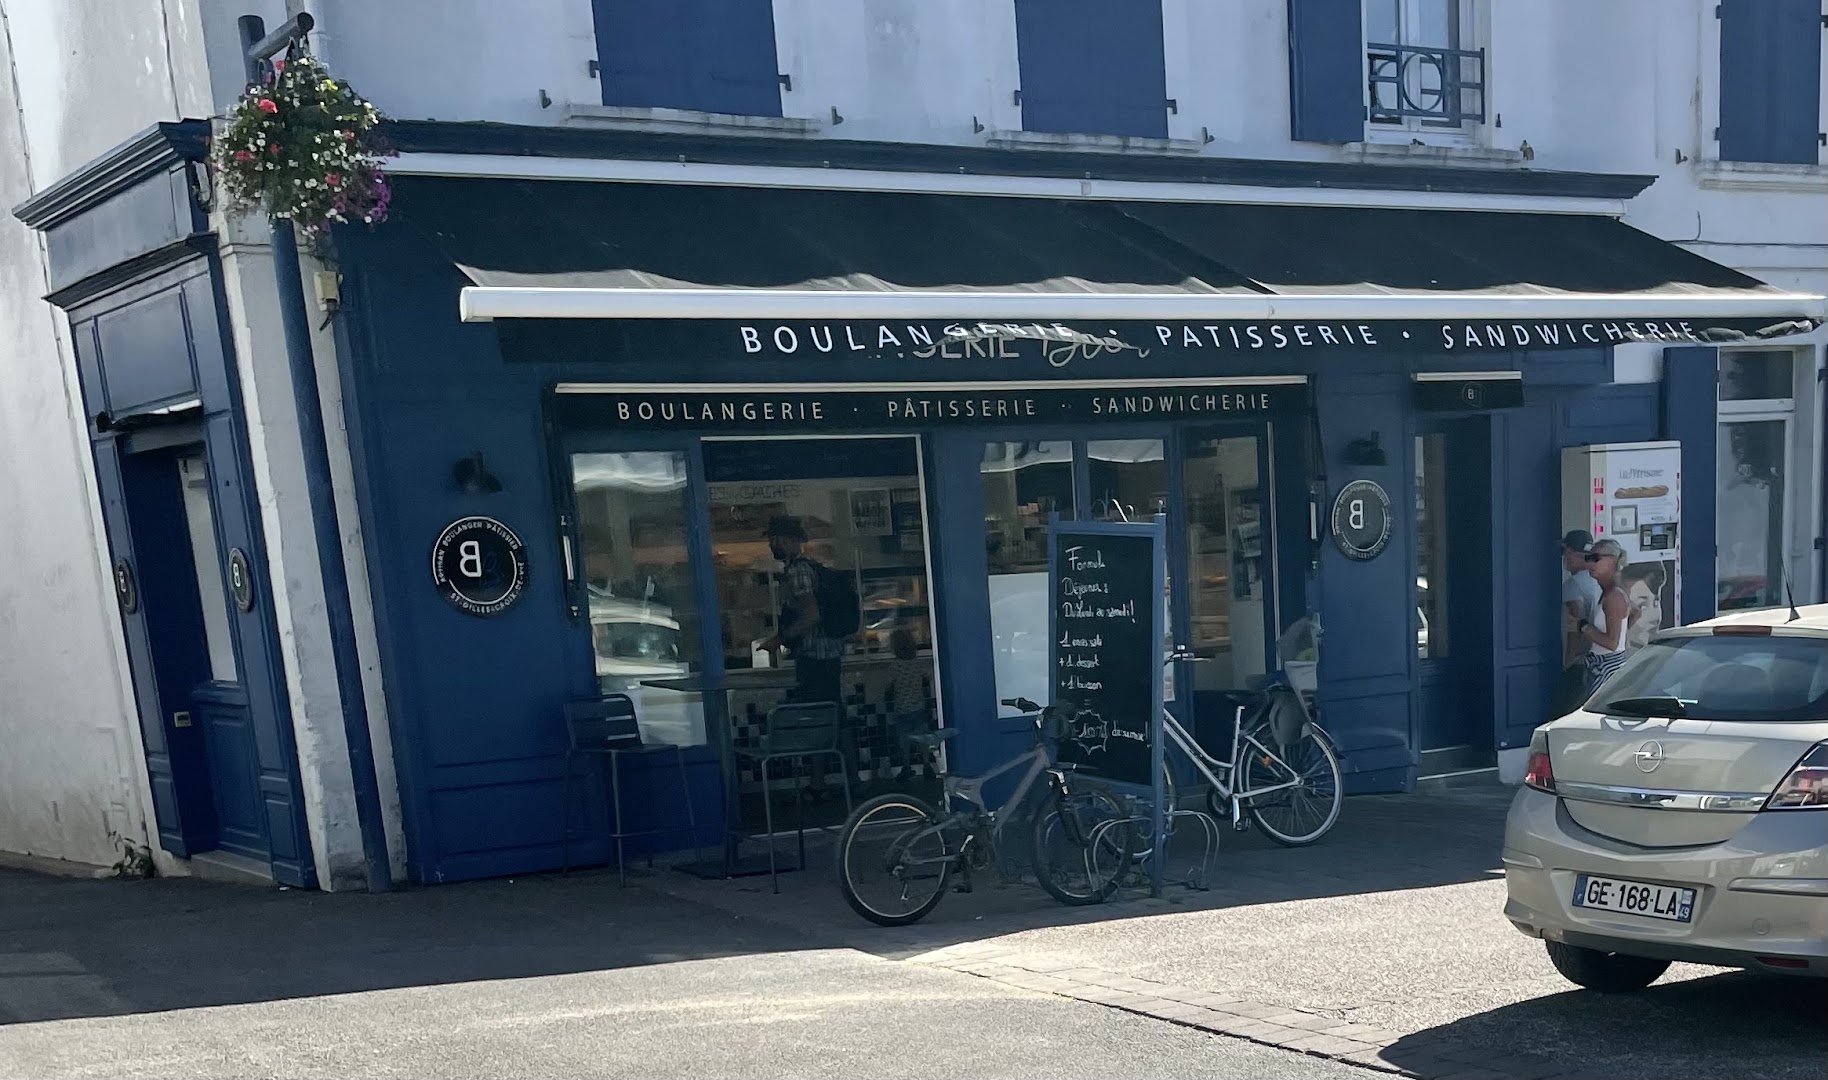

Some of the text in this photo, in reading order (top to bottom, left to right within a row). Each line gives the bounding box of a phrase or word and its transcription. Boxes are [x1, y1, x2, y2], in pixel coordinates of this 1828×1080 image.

[740, 322, 1074, 354] BOULANGERIE
[1156, 322, 1377, 351] PATISSERIE
[1443, 320, 1699, 350] SANDWICHERIE
[617, 392, 1270, 421] BOULANGERIE PÂTISSERIE SANDWICHERIE
[442, 521, 483, 547] BOULANGER
[1059, 629, 1071, 648] 1
[1587, 879, 1678, 916] GE-168-LA
